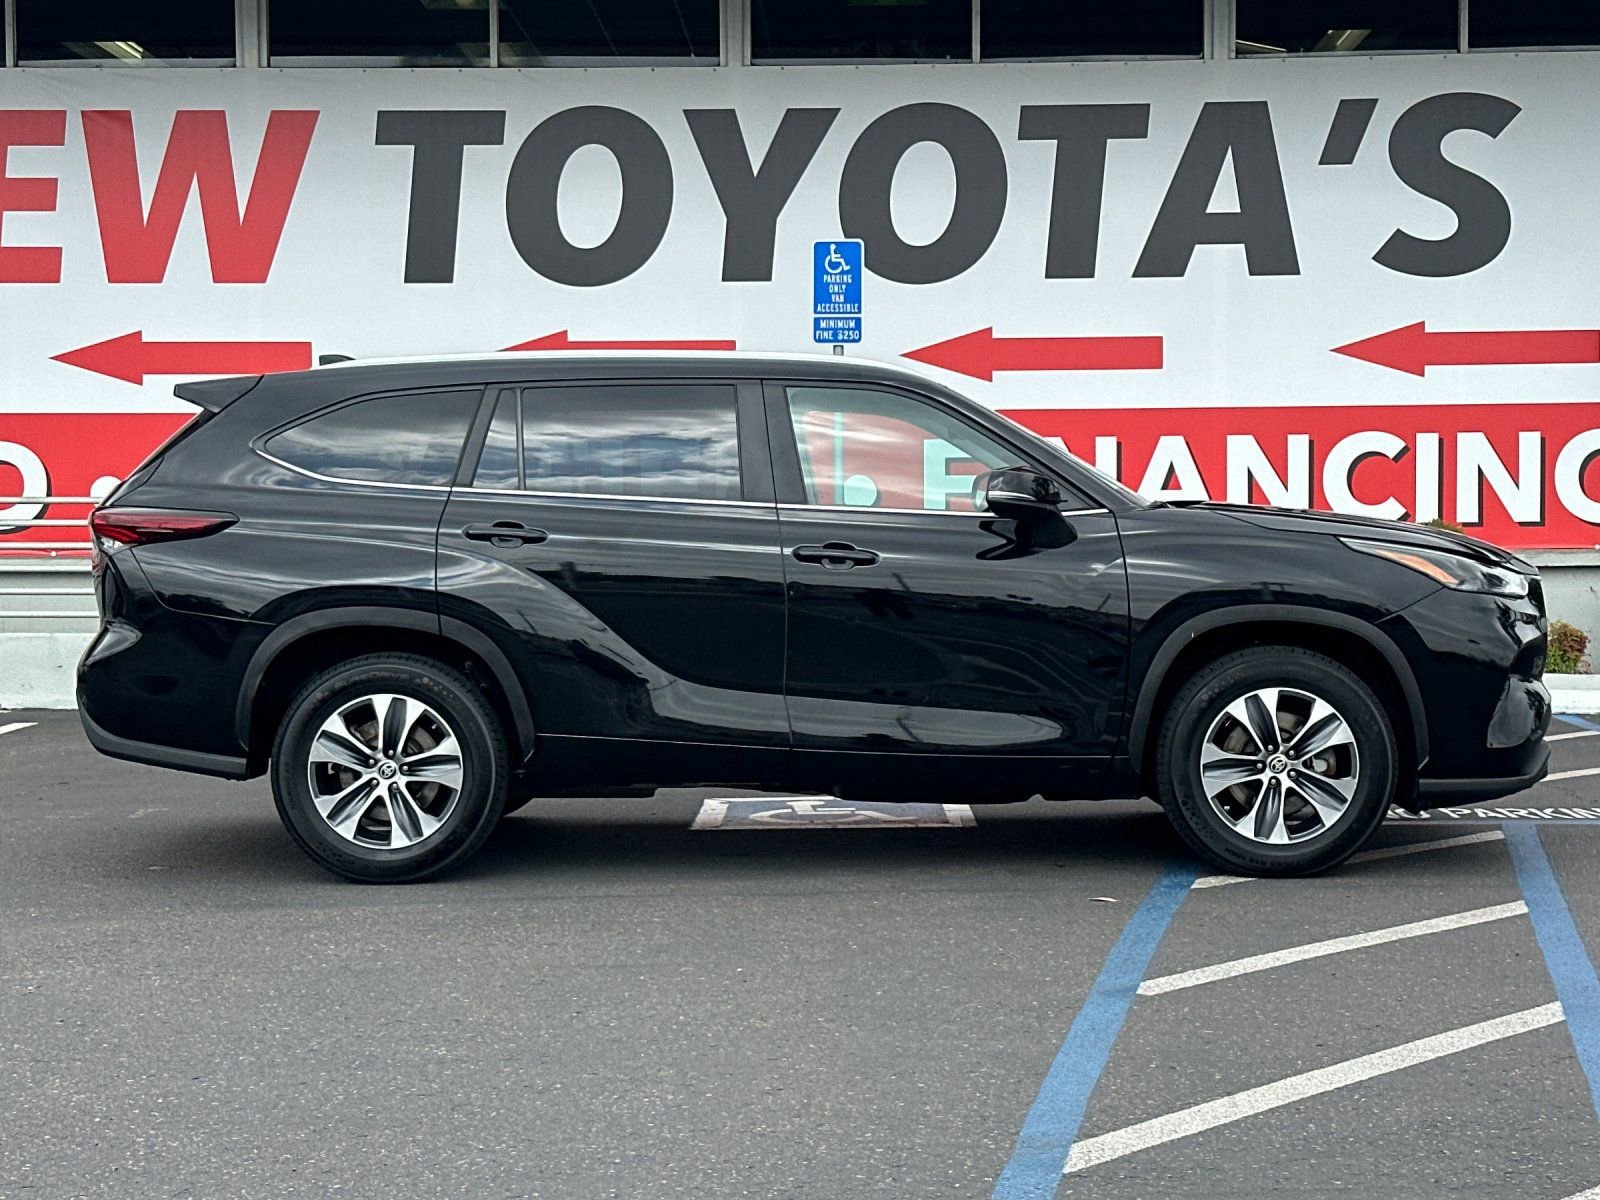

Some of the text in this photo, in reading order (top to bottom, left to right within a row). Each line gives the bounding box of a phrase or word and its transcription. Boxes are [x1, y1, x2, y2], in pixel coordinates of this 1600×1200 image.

[374, 92, 1523, 286] TOYOTA'S
[823, 274, 853, 284] PARKING
[829, 284, 847, 293] ONLY
[831, 294, 845, 303] VAN
[816, 303, 859, 313] ACCESSIBLE
[820, 319, 856, 329] MINIMUM
[815, 329, 860, 341] FINE $250
